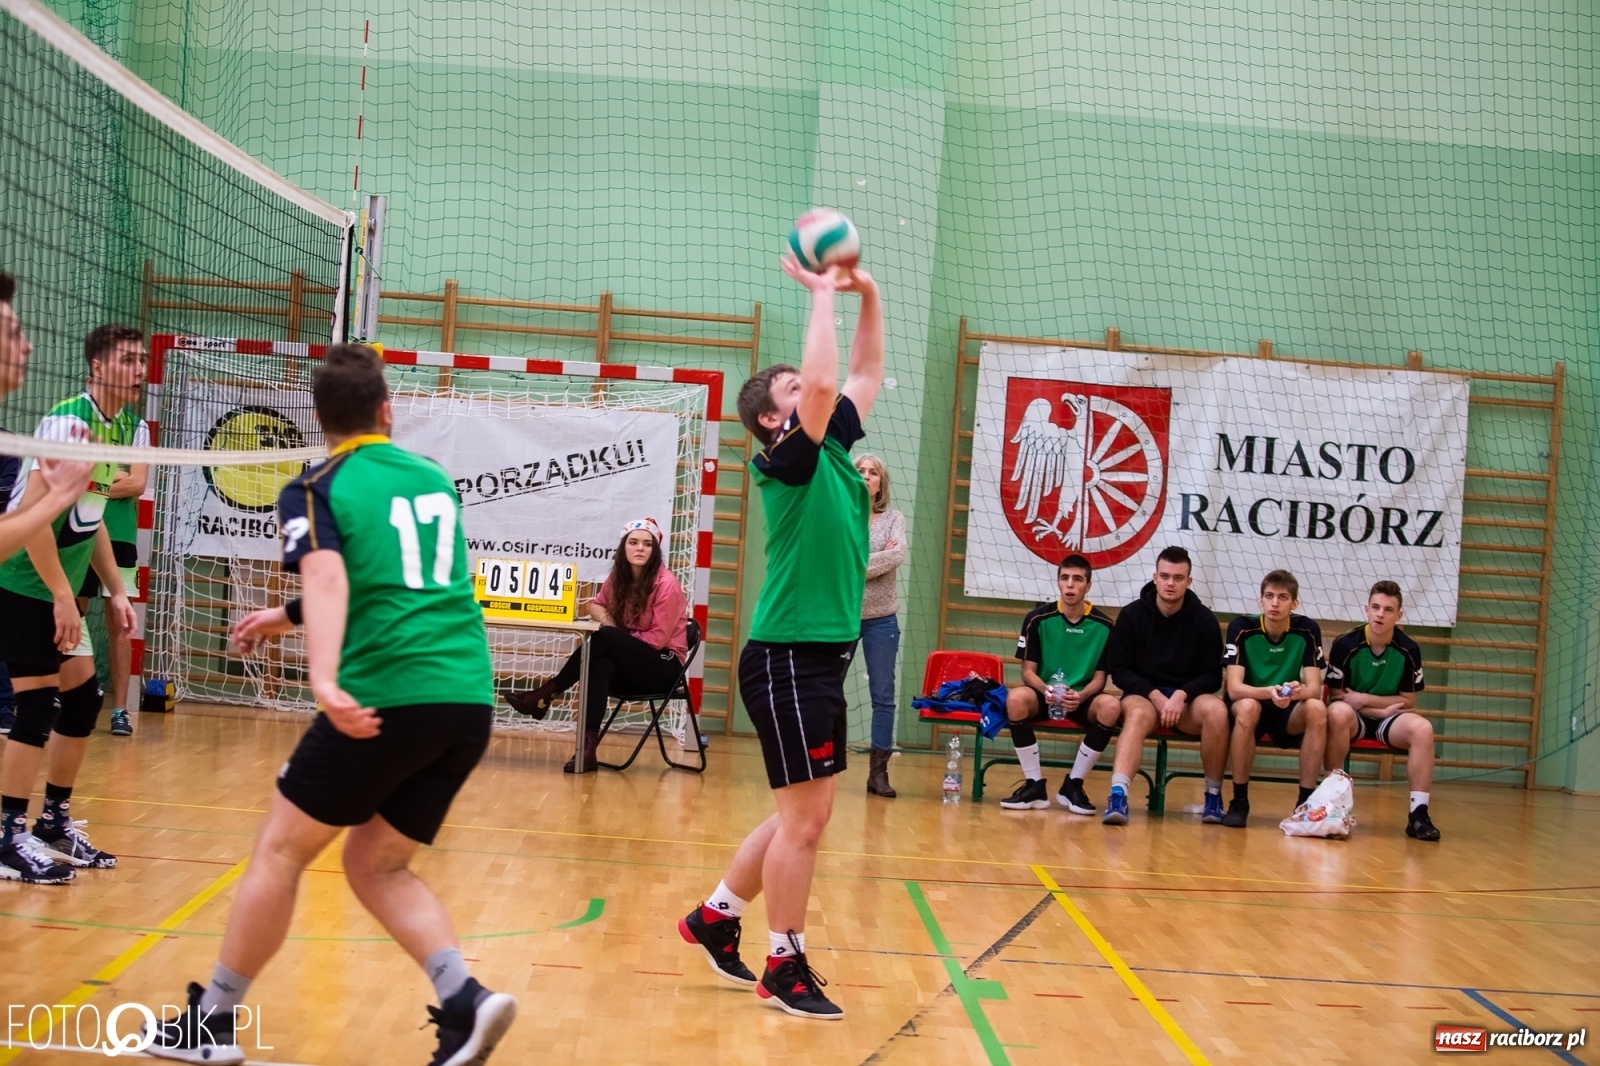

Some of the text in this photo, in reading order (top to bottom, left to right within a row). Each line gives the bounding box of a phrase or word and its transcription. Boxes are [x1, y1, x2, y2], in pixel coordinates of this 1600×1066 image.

[1213, 433, 1416, 485] MIASTO
[198, 515, 279, 540] RACIBÓ
[389, 491, 457, 590] 17
[1176, 493, 1445, 549] RACIBÓRZ
[464, 538, 620, 561] ww.osir-racibor
